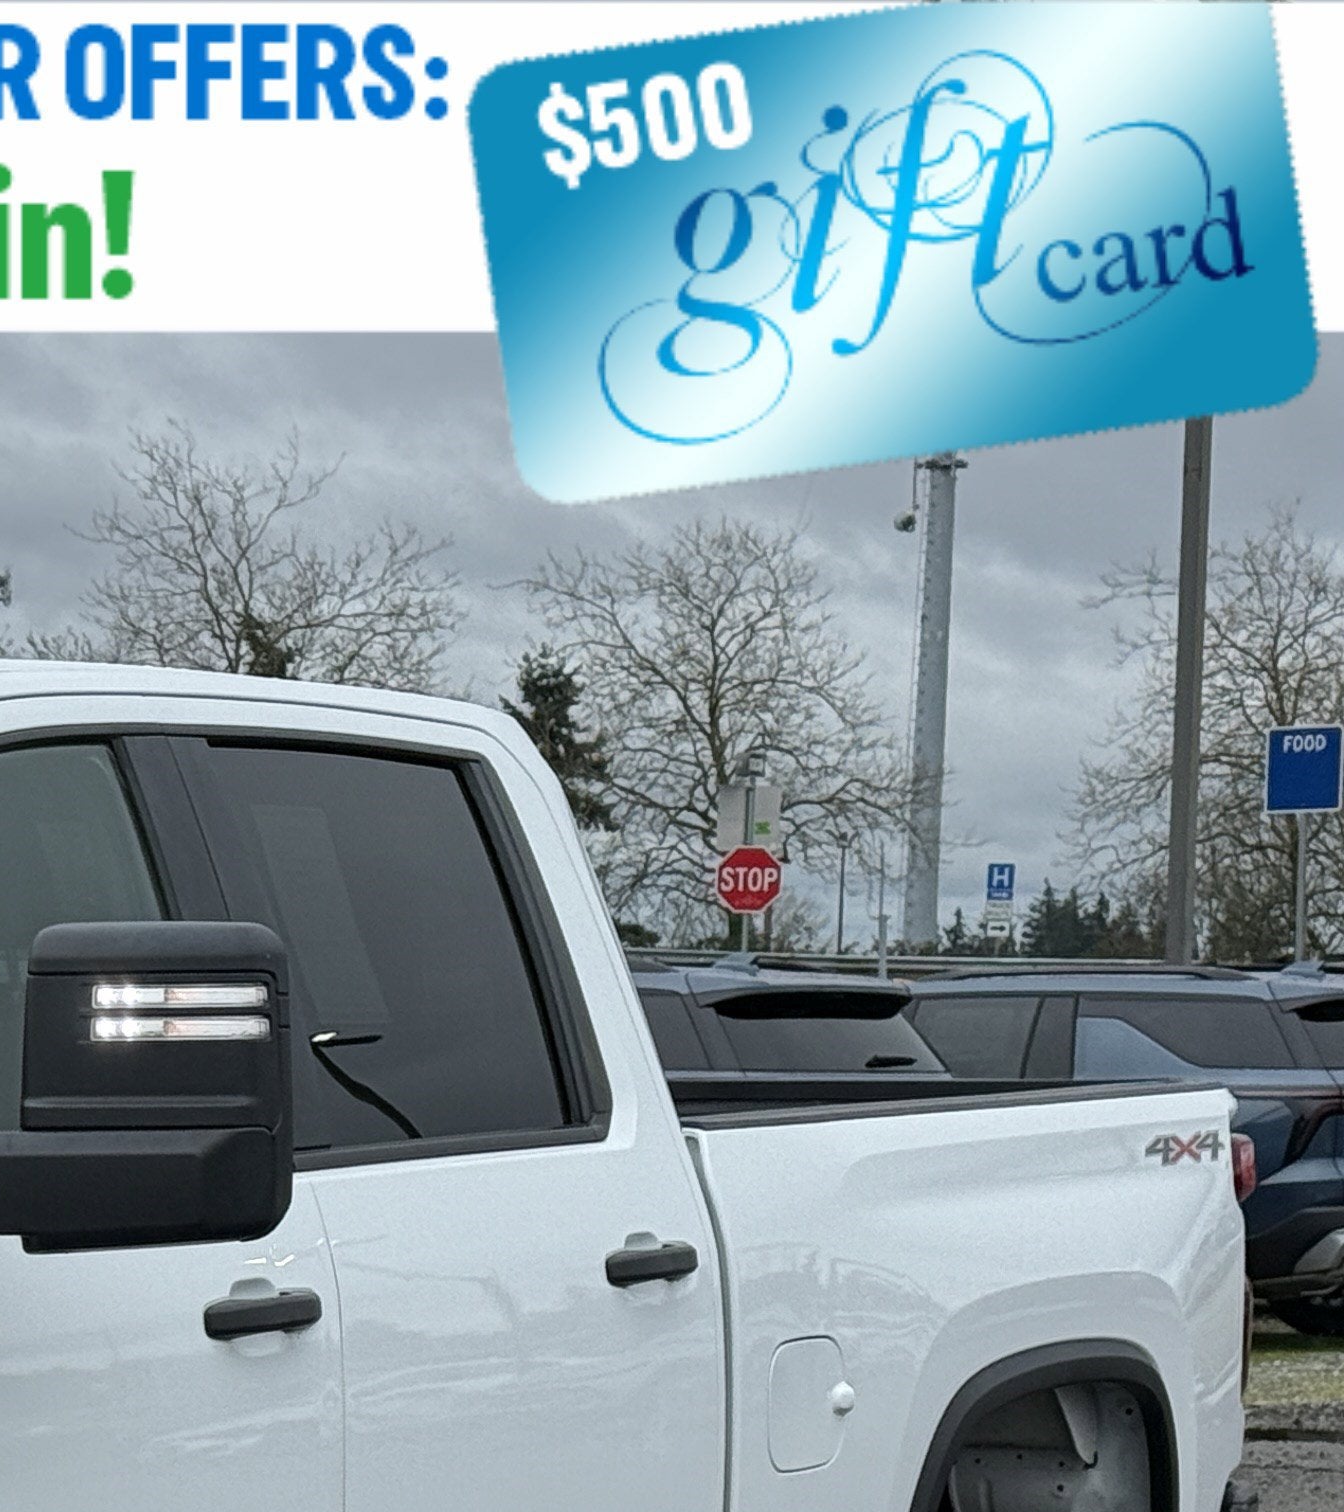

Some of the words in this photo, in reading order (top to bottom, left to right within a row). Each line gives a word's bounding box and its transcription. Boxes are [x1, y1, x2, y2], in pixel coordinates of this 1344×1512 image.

[1283, 734, 1327, 753] FOOD
[720, 866, 779, 893] STOP
[992, 866, 1010, 887] H
